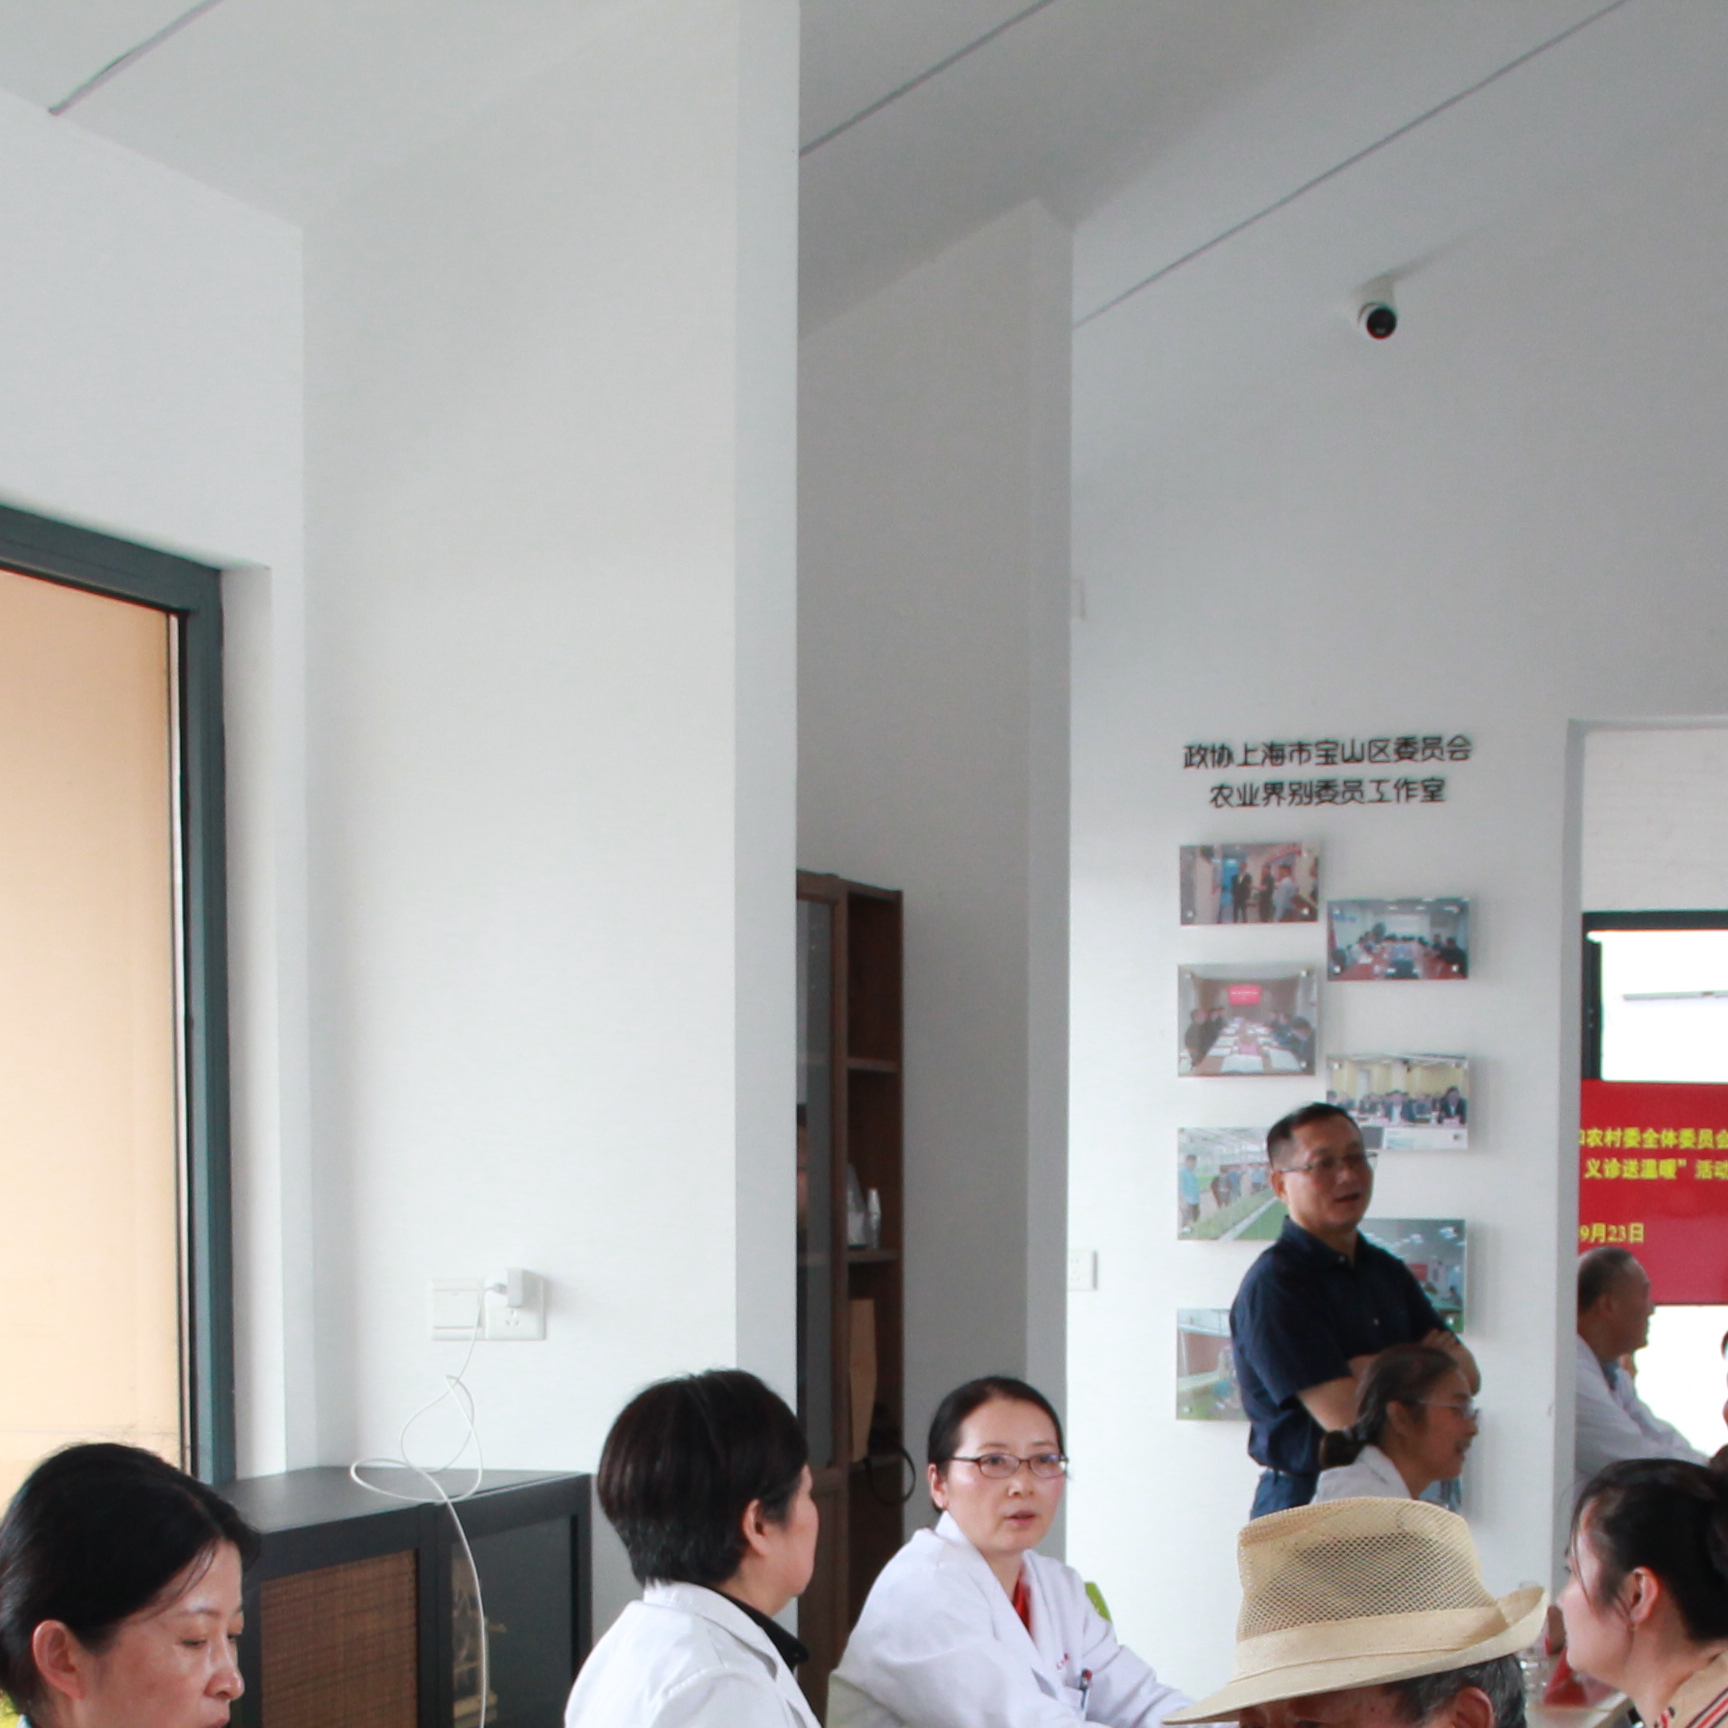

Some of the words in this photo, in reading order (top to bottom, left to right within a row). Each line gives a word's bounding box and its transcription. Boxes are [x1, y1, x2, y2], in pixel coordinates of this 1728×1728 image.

[1183, 734, 1472, 769] 政协上海市宝山区委员会
[1210, 776, 1446, 809] 农业界别委员工作室
[1579, 1222, 1645, 1243] 9月23日
